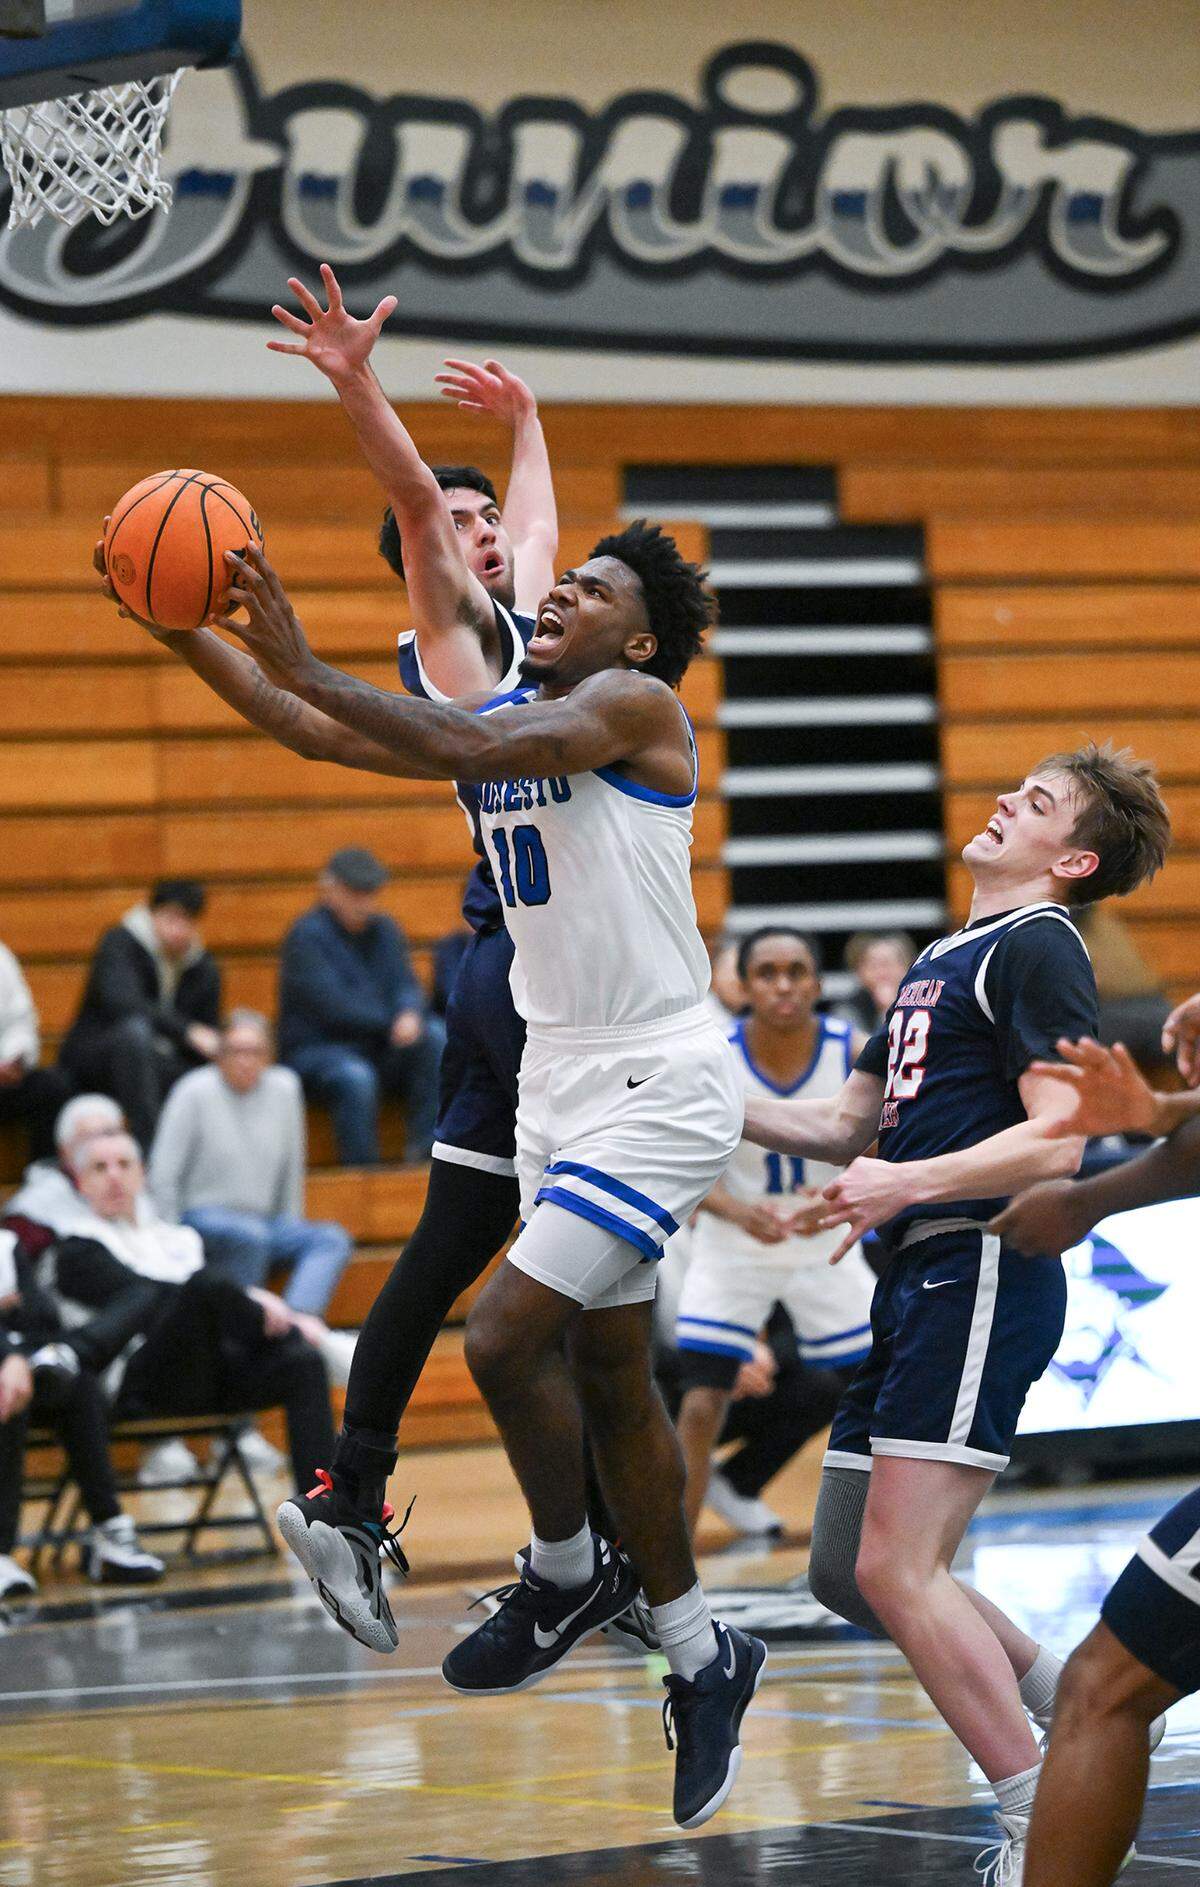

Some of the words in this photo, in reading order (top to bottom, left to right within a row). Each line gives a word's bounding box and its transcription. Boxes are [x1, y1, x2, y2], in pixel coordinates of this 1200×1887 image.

[0, 42, 1178, 322] Junior
[491, 824, 552, 908] 10
[765, 1152, 805, 1194] 11
